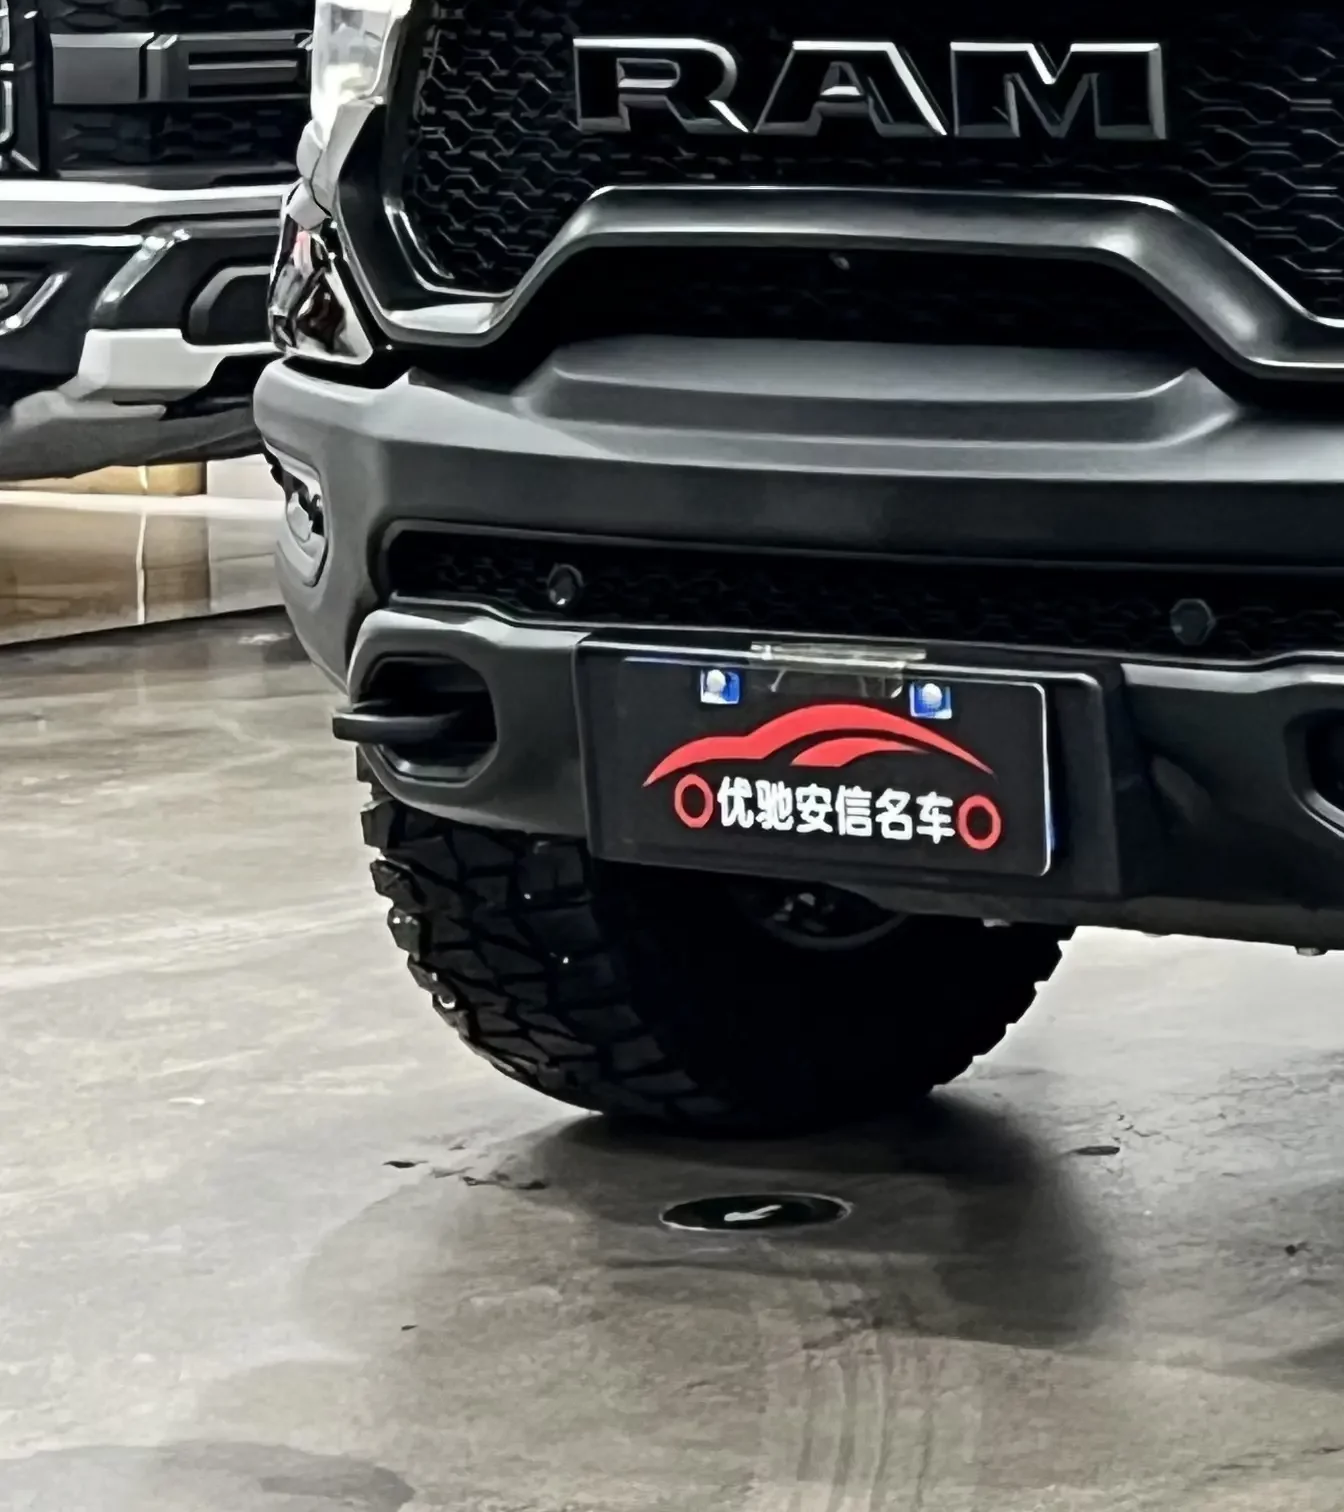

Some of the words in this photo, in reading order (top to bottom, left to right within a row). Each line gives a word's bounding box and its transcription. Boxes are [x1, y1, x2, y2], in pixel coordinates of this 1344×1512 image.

[573, 38, 1166, 139] RAM
[717, 775, 956, 844] 优驰安信名车
